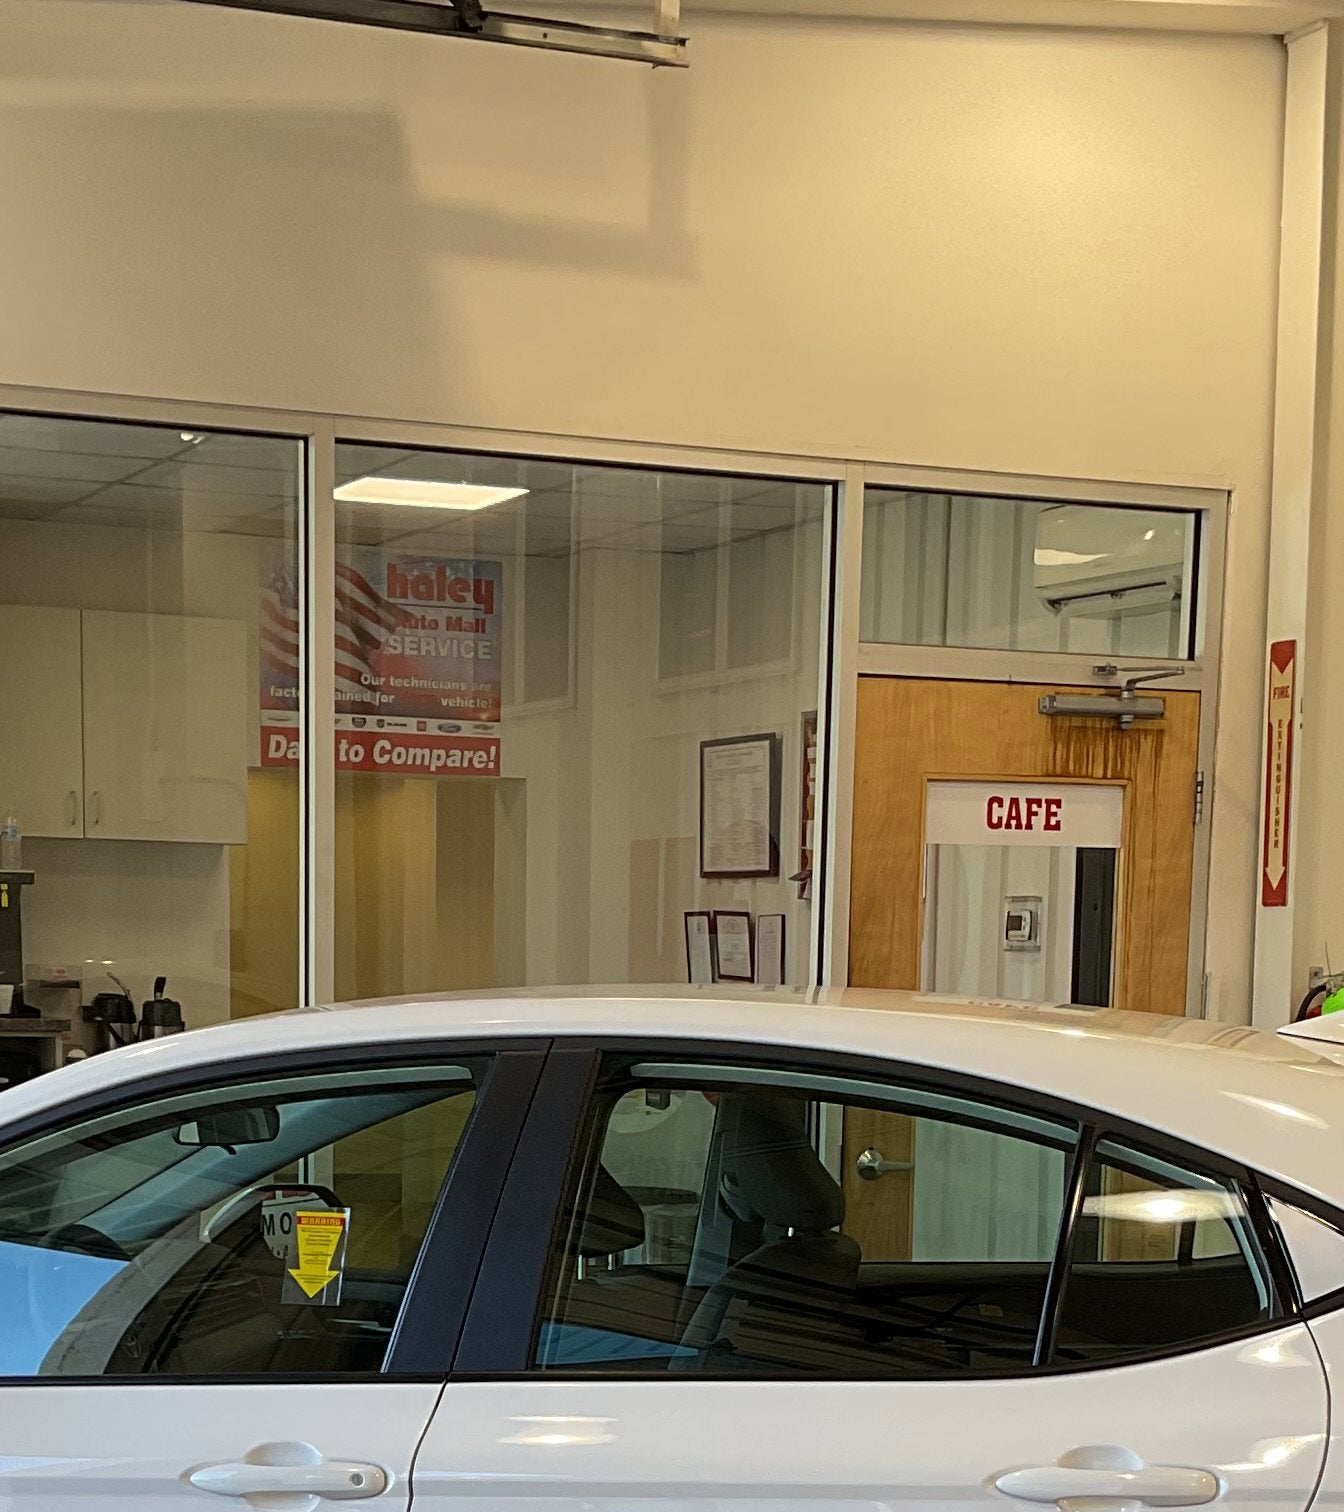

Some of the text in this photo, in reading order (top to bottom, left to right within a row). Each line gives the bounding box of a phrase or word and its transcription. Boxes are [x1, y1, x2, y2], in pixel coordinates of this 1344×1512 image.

[387, 562, 495, 615] haley
[446, 615, 487, 633] Mall
[387, 635, 493, 660] SERVICE
[361, 674, 386, 685] Our
[390, 676, 466, 690] technicians
[1272, 685, 1290, 700] FIRE
[335, 691, 371, 702] ained
[376, 691, 395, 706] for
[339, 739, 364, 762] to
[373, 739, 496, 771] Compare!
[1274, 719, 1284, 849] EXTINGUISHER
[986, 796, 1063, 831] CAFE
